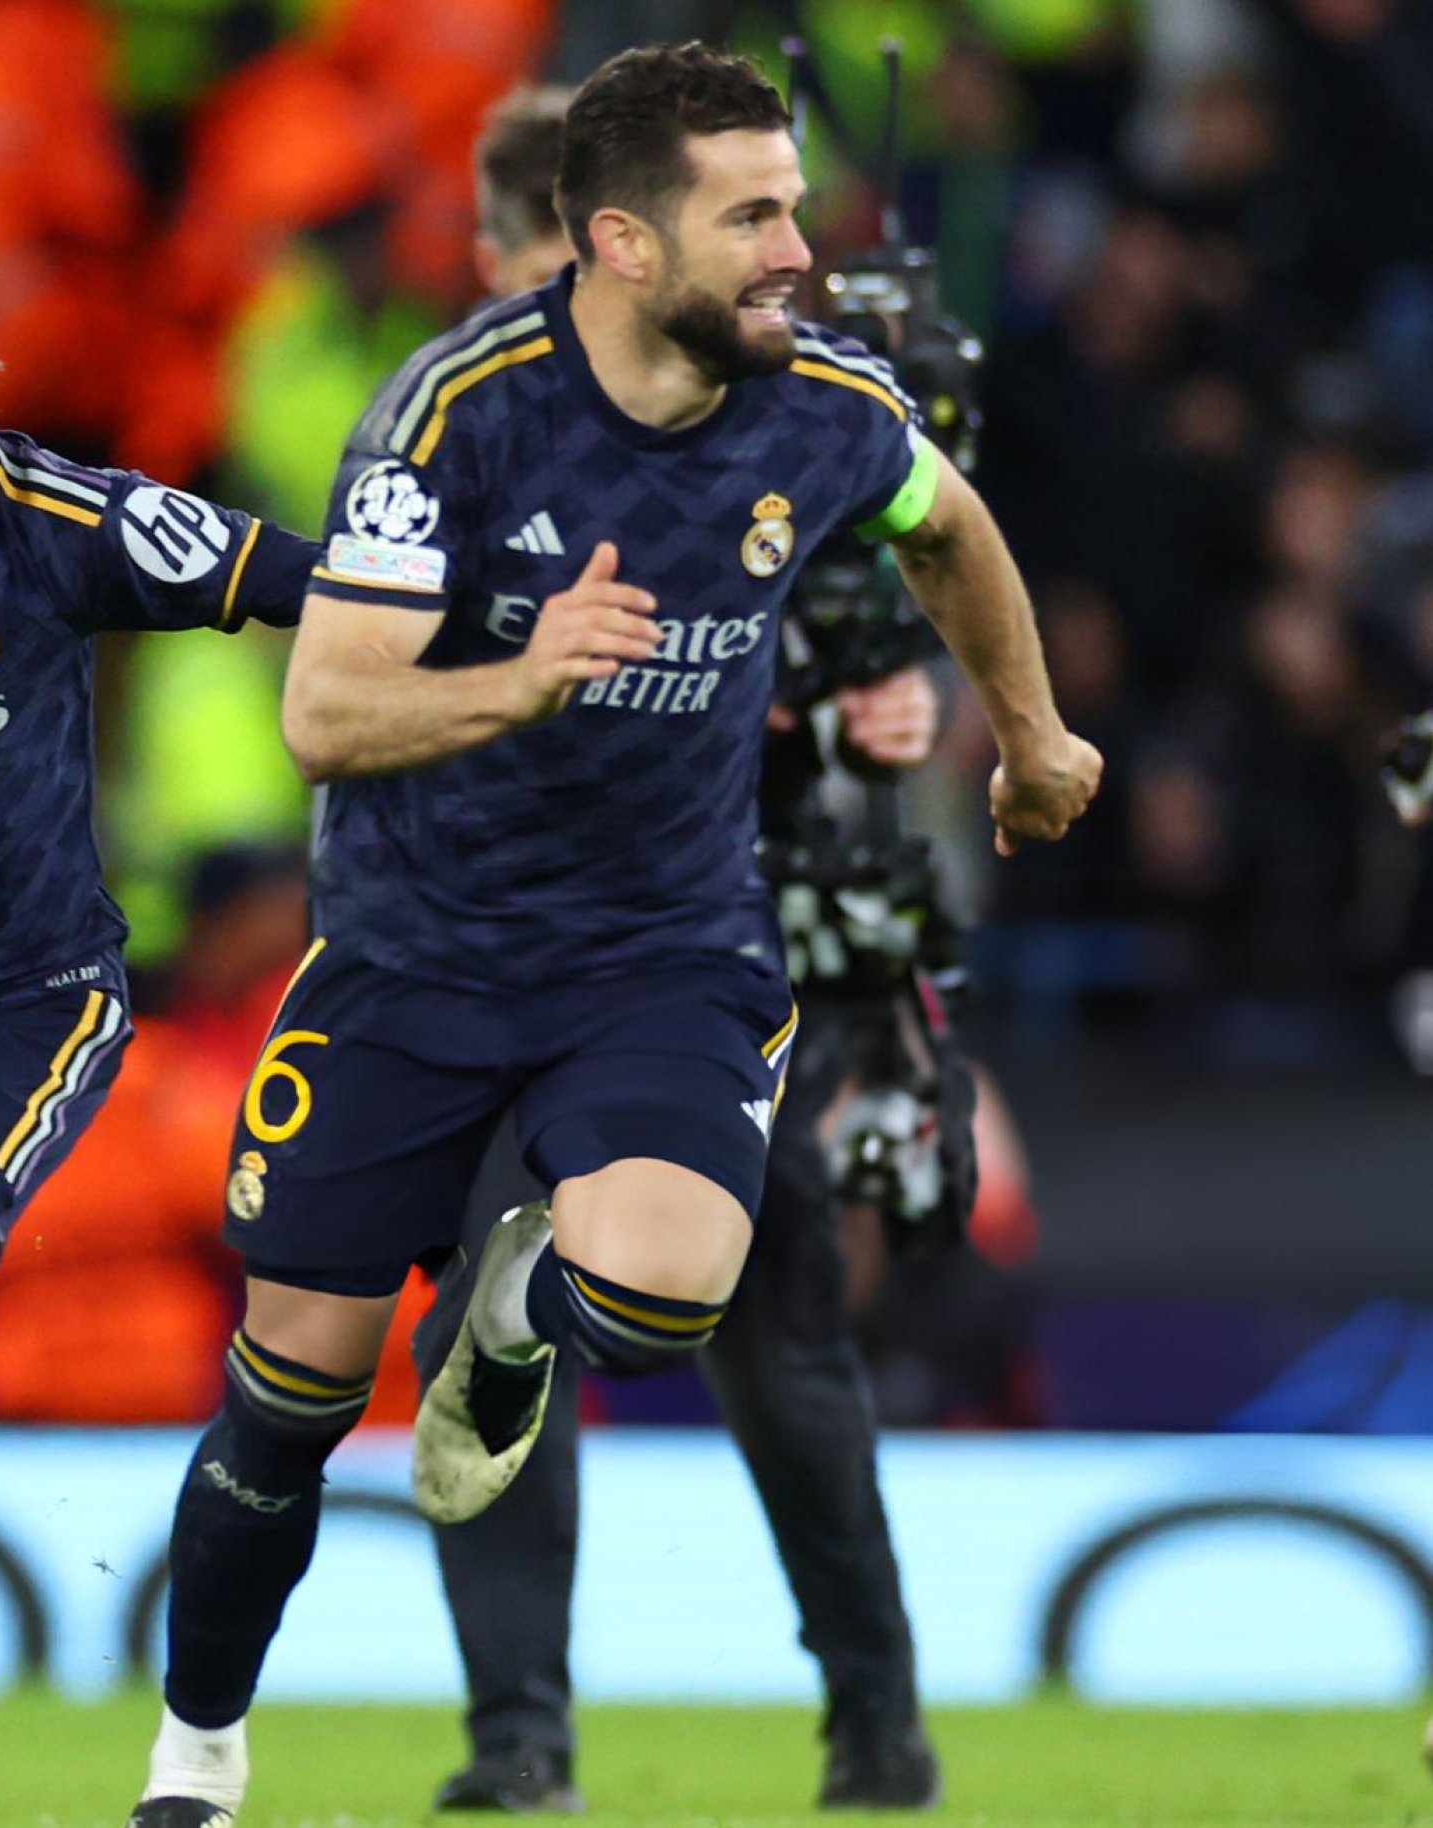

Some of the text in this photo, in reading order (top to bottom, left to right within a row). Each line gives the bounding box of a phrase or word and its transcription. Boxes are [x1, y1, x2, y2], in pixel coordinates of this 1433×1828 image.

[122, 490, 223, 575] hp
[485, 592, 767, 664] Eates
[246, 1029, 329, 1143] 6
